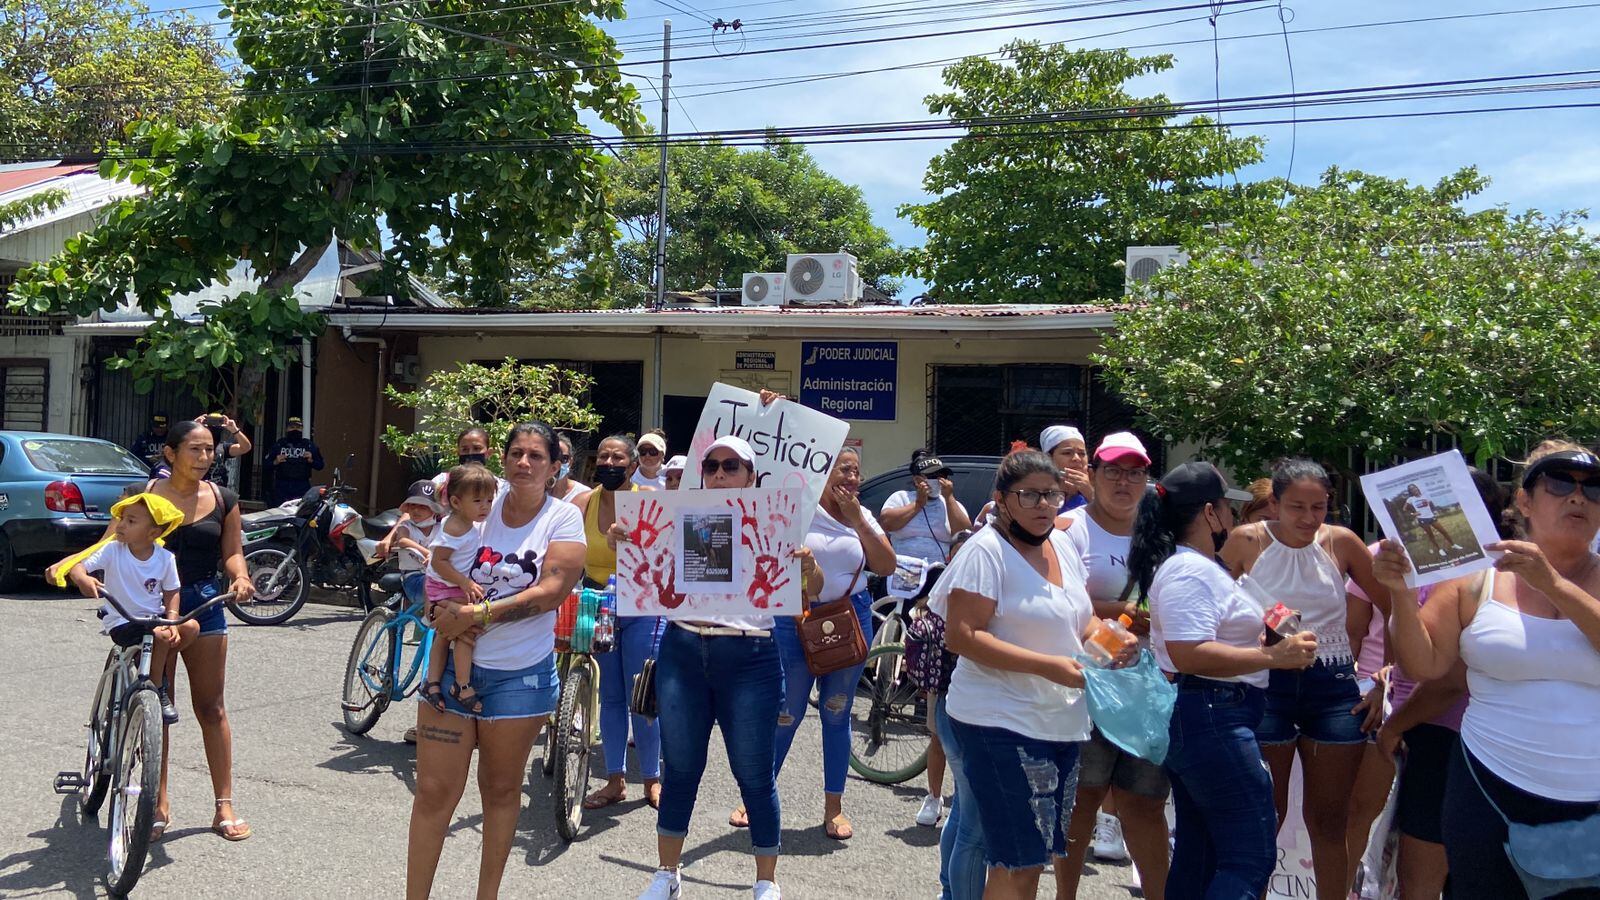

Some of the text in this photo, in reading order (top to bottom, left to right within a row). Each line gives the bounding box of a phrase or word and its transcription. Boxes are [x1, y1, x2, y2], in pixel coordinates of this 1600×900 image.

[819, 348, 895, 361] PODER JUDICIAL
[803, 377, 893, 391] Administración
[821, 396, 873, 412] Regional
